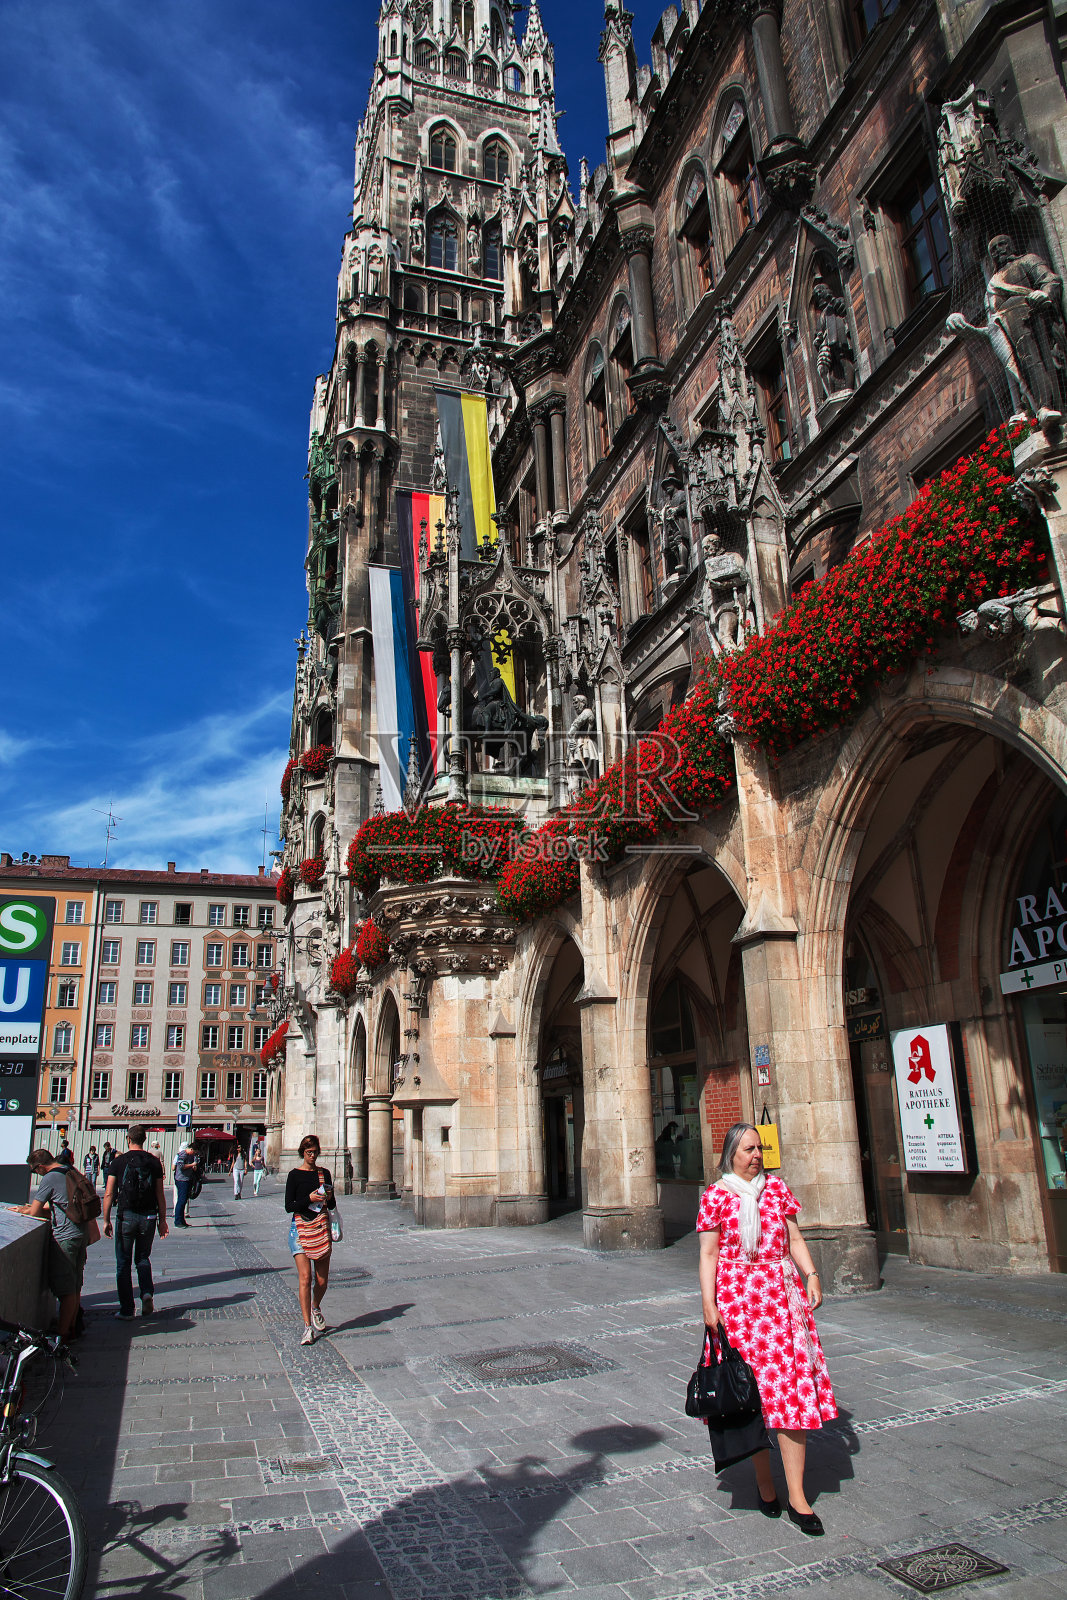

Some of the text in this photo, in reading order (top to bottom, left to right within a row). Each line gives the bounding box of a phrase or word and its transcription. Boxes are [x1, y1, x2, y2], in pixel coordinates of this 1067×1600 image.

[0, 904, 37, 950] S
[909, 1088, 943, 1098] RATHAUS
[905, 1098, 950, 1110] APOTHEKE
[179, 1114, 188, 1126] U
